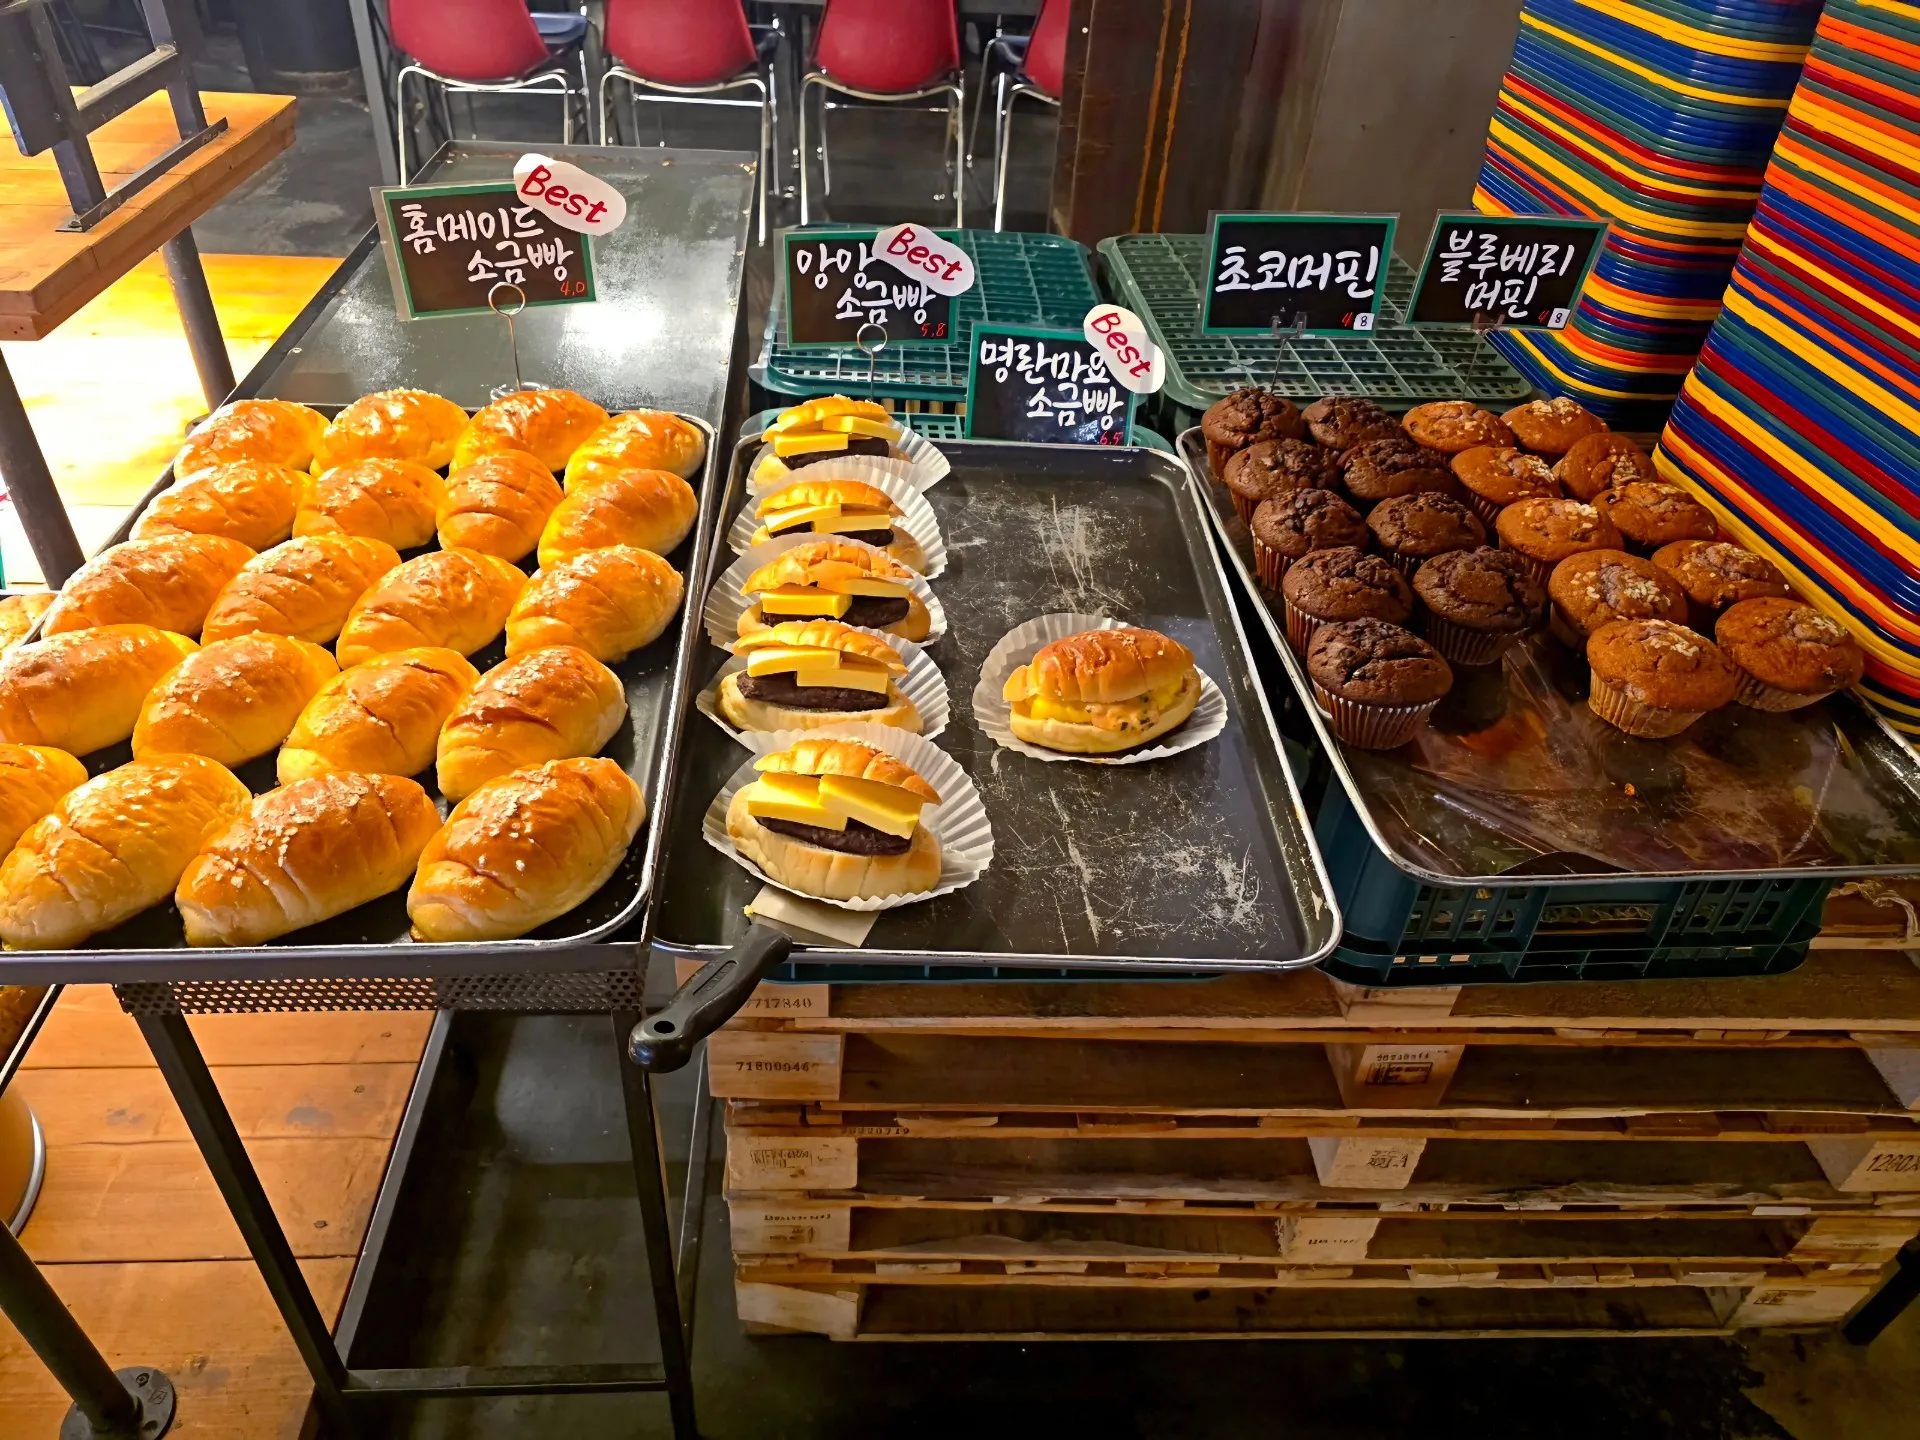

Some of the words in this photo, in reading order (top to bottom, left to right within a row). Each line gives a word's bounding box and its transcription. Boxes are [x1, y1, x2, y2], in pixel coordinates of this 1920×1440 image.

[520, 164, 608, 224] Best
[400, 203, 544, 255] 홈메이드
[887, 226, 963, 281] Best
[467, 237, 574, 284] 소금빵
[796, 242, 877, 289] 앙앙
[1215, 245, 1379, 299] 초코머핀
[1439, 229, 1575, 283] 블루베리
[835, 280, 936, 325] 소금빵
[1464, 275, 1538, 319] 머핀
[980, 338, 1111, 385] 명란마요
[1091, 312, 1151, 378] Best
[1026, 382, 1124, 431] 소금빵
